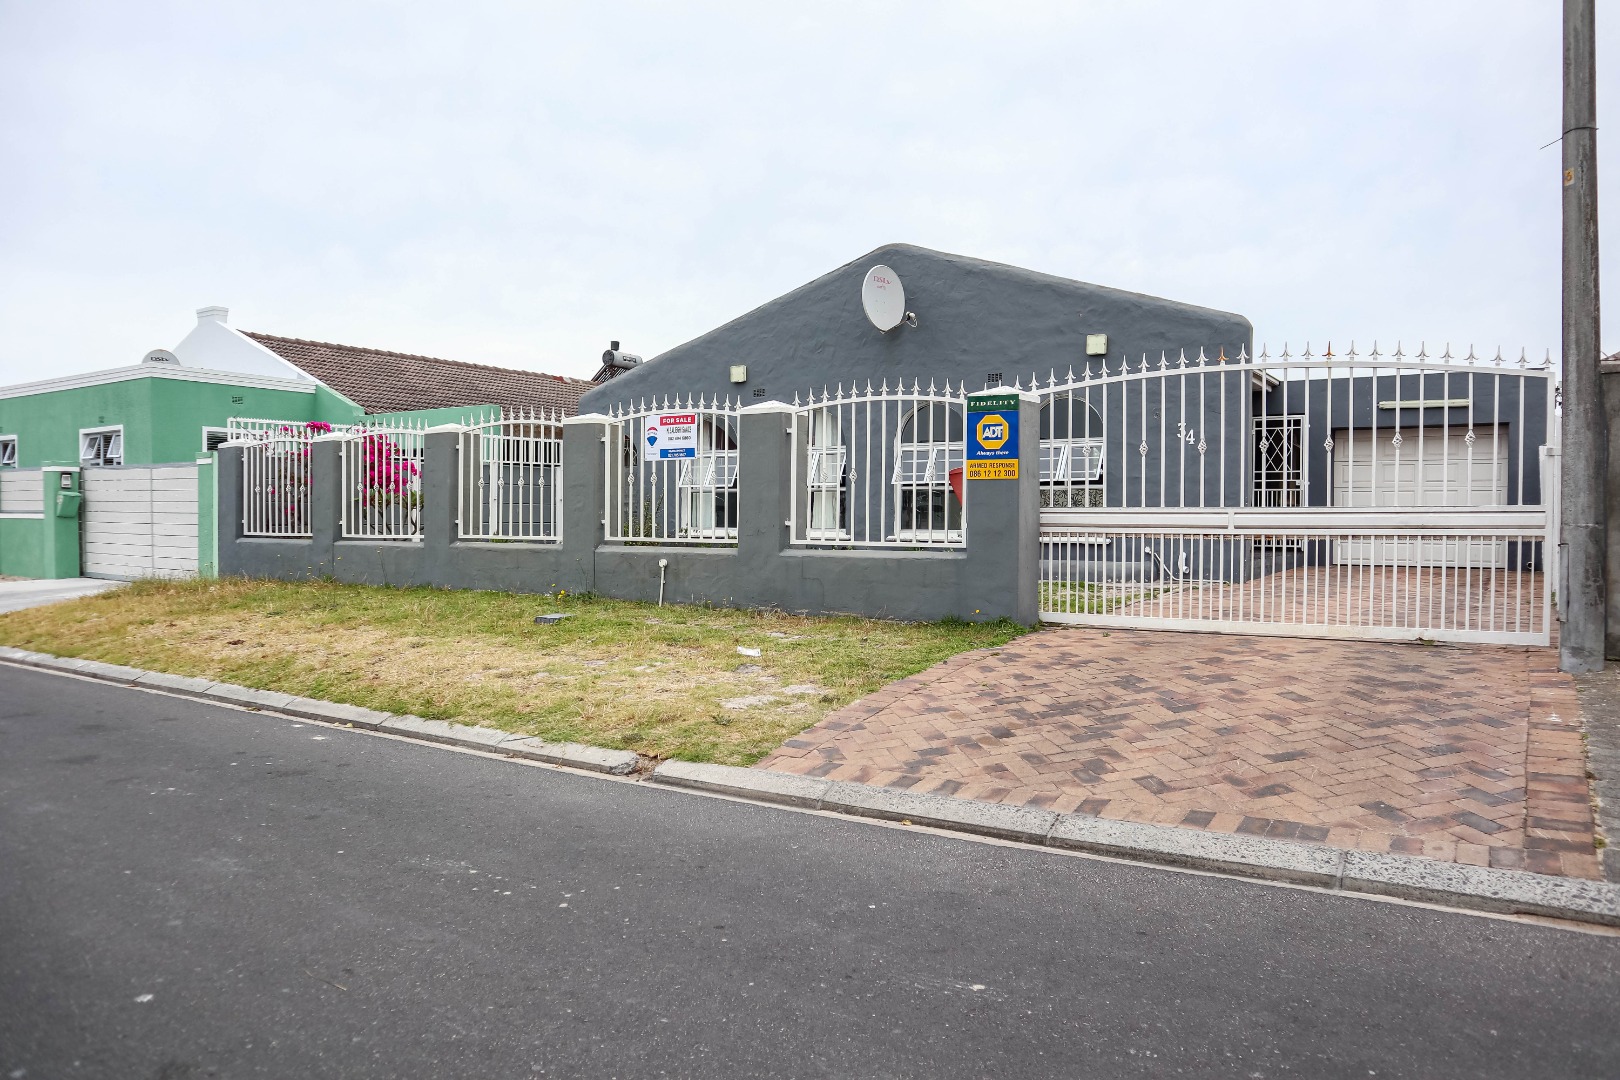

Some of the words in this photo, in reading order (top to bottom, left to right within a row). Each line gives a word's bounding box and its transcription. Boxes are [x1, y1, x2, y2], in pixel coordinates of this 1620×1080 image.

[970, 399, 1016, 407] FIDELITY
[983, 425, 1003, 438] ADT
[1177, 422, 1196, 445] 34
[969, 470, 982, 478] 086
[984, 470, 992, 478] 12
[994, 469, 1002, 477] 12
[1003, 469, 1016, 477] 300
